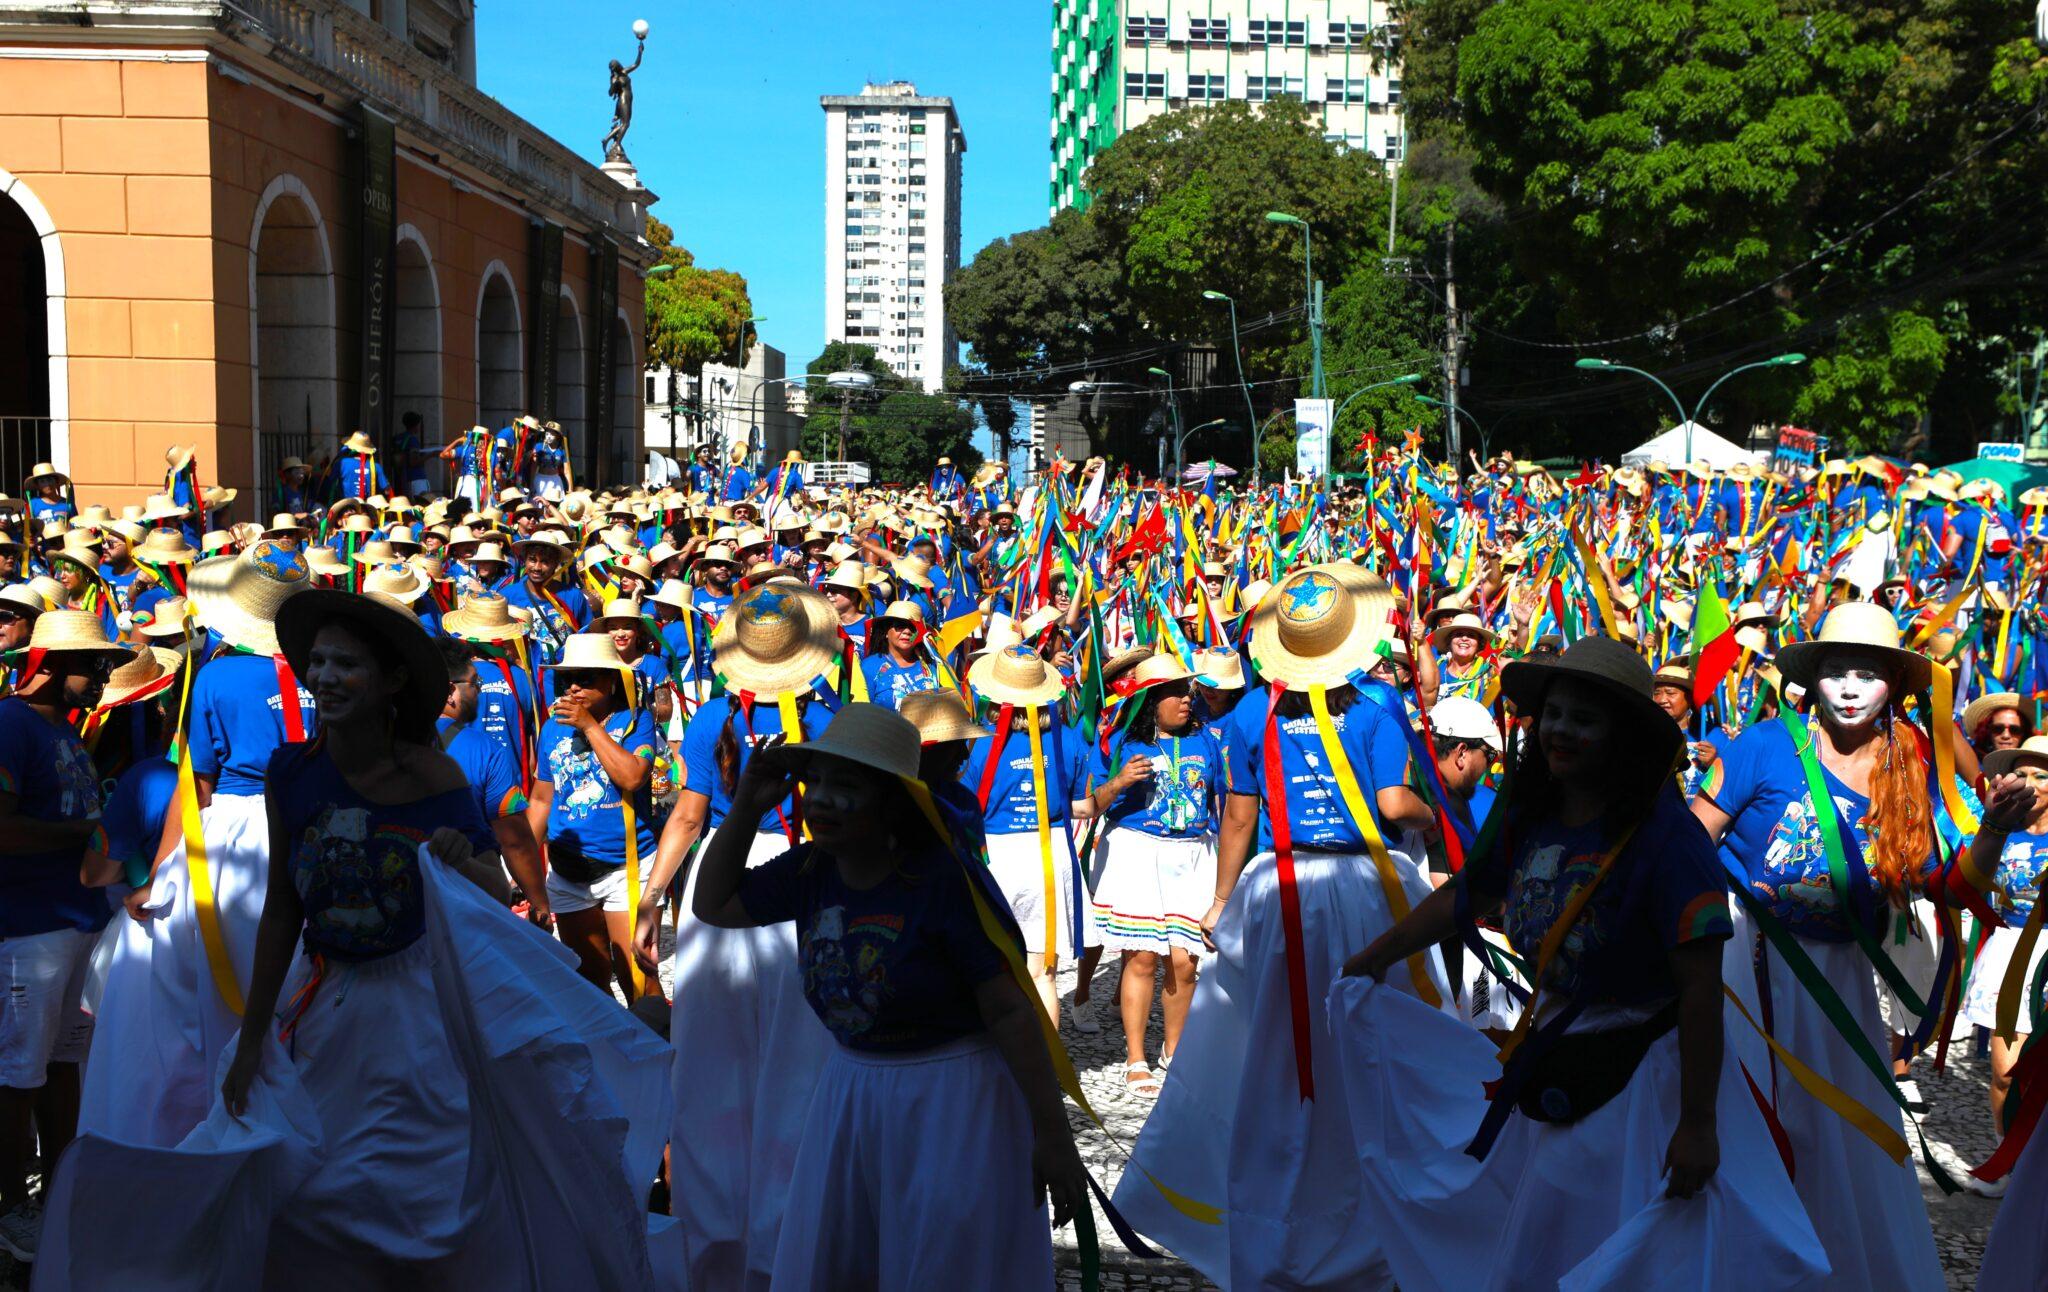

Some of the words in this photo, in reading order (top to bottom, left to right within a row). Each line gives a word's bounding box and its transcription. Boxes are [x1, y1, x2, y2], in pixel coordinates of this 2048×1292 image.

[369, 257, 384, 361] HERÓIS
[368, 372, 381, 407] OS
[1282, 717, 1317, 731] BATALH
